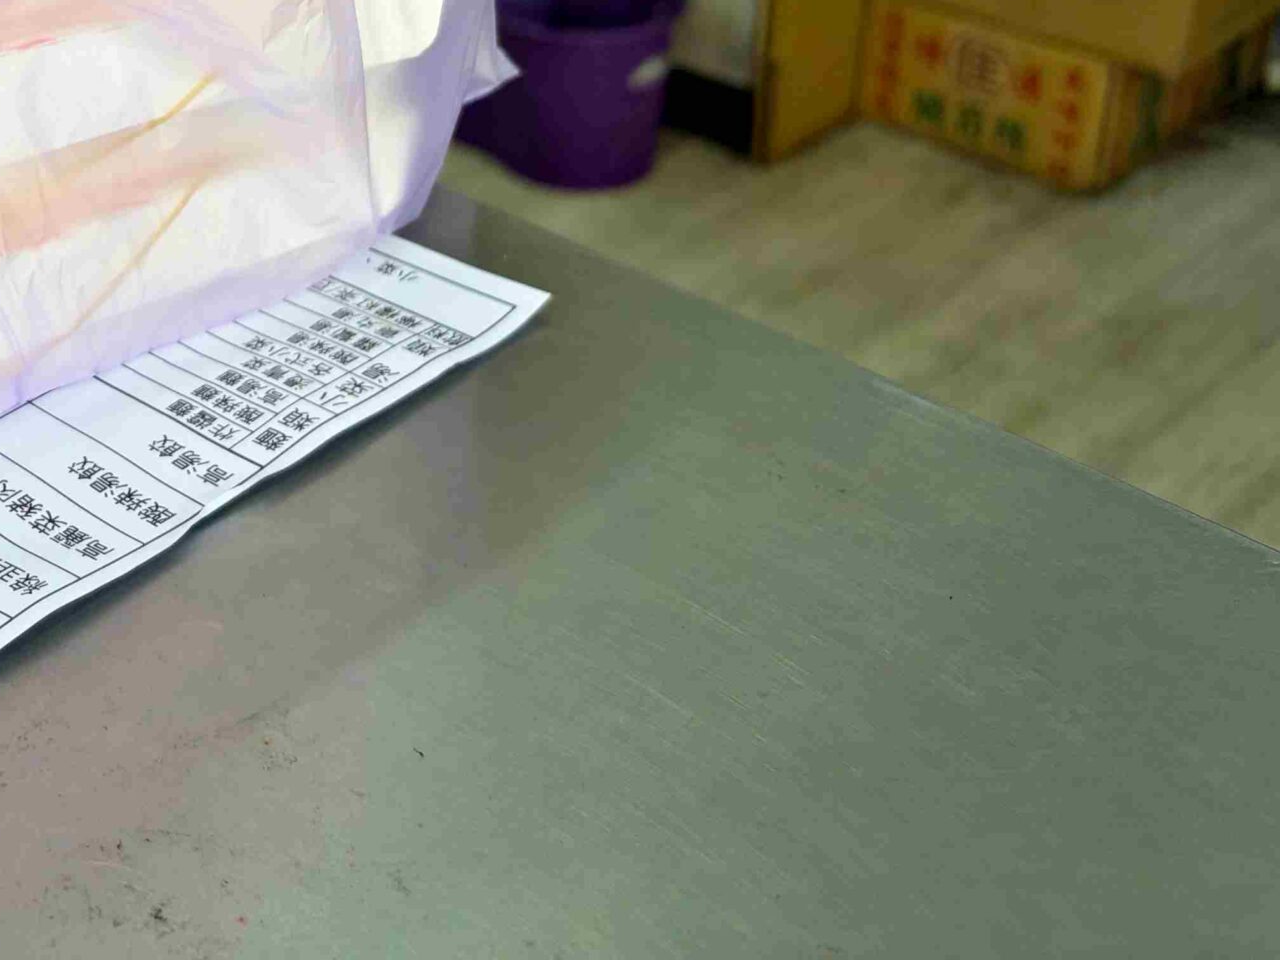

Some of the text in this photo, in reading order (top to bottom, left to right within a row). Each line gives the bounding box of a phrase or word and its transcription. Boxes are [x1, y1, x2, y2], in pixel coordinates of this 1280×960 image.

[287, 332, 359, 365] 酸辣湯
[427, 323, 467, 350] 飲料
[241, 353, 313, 390] 燙青菜
[245, 336, 333, 383] 各式小菜
[191, 384, 265, 425] 酸辣麵
[215, 369, 289, 406] 高湯麵
[166, 399, 242, 440] 炸醬麵
[149, 435, 234, 487] 高湯餃
[68, 456, 177, 527] 酸辣湯餃
